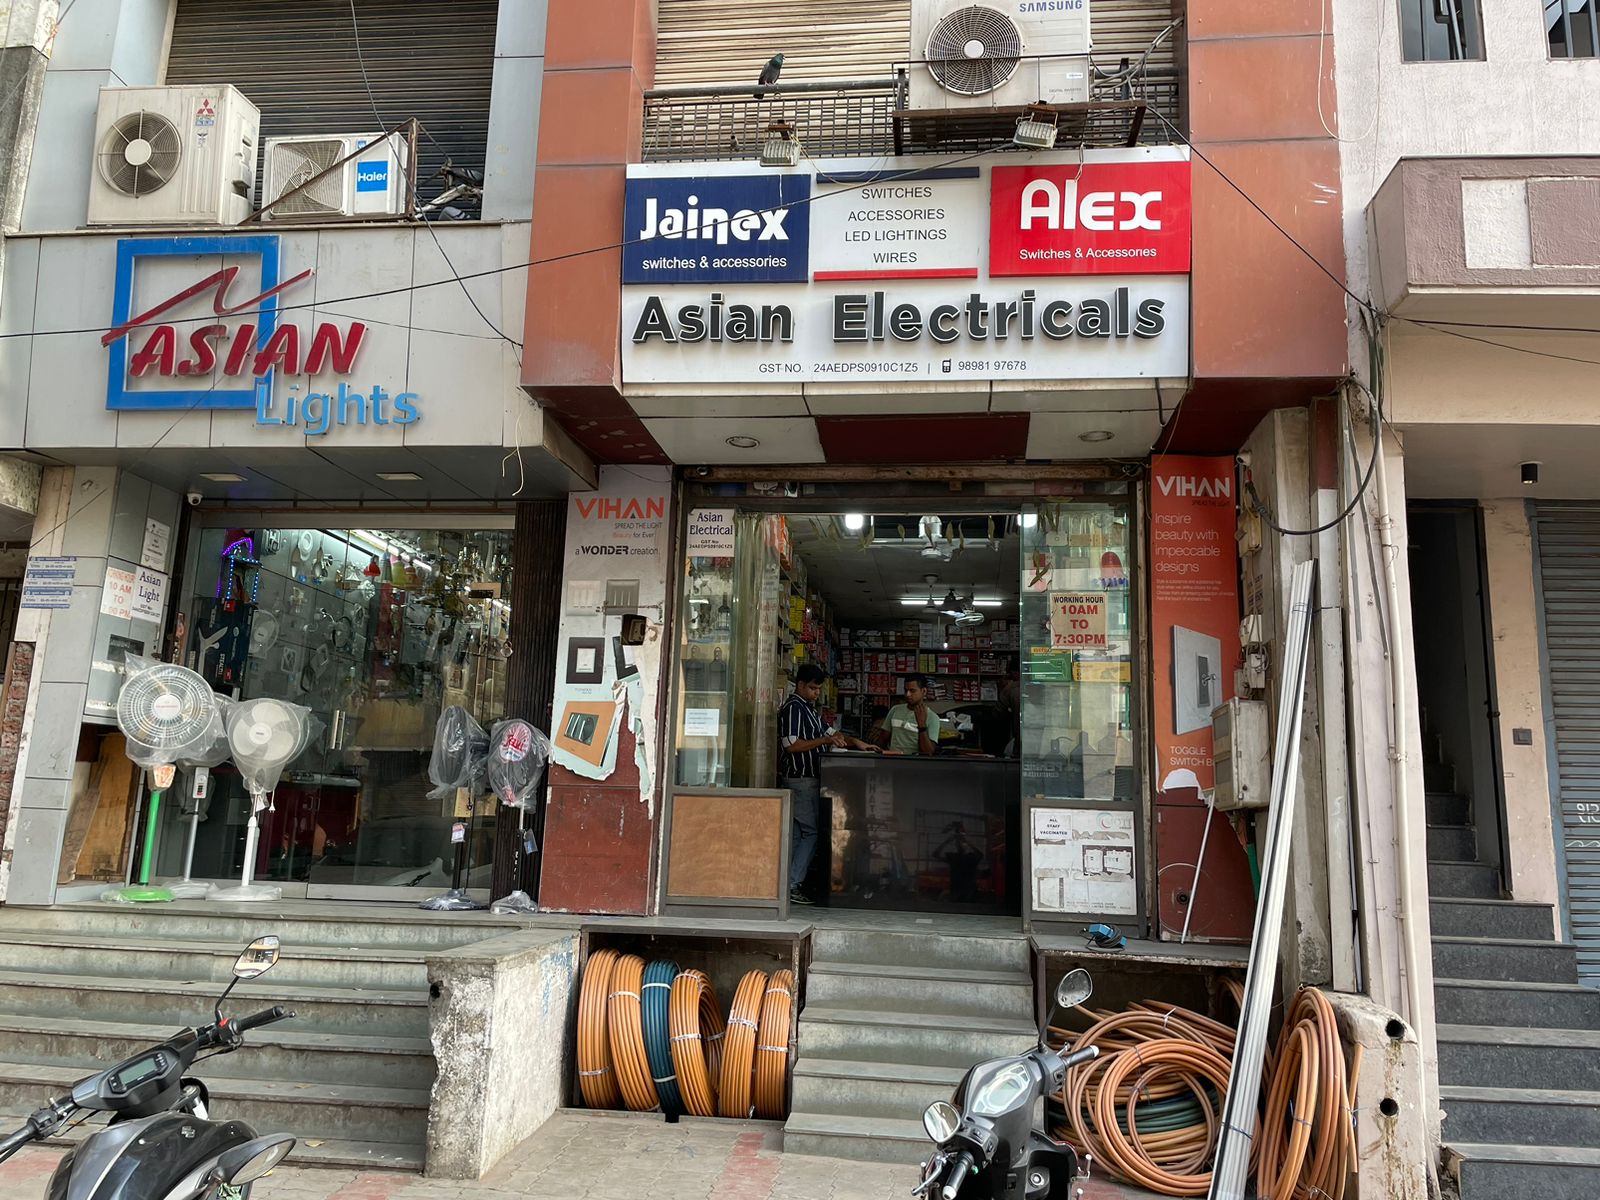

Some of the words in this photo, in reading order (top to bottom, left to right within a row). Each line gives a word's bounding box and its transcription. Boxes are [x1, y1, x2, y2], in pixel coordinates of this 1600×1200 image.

[1019, 0, 1083, 13] SAMSUNG
[357, 171, 388, 182] Haier
[861, 186, 933, 200] SWITCHES
[847, 208, 945, 222] ACCESSORIES
[844, 229, 870, 242] LED
[873, 228, 948, 242] LIGHTINGS
[873, 251, 918, 264] WIRES
[1019, 247, 1072, 260] Switches
[1074, 247, 1084, 259] &
[1086, 245, 1157, 260] Accessories
[642, 256, 697, 270] switches
[699, 257, 709, 269] &
[712, 255, 787, 269] accessories
[632, 291, 794, 345] Asian
[833, 286, 1166, 342] Electricals
[130, 322, 368, 378] ASIAN
[758, 362, 781, 374] GST
[783, 362, 804, 374] NO.
[813, 361, 919, 374] 24AEDPS0910C1Z5
[957, 360, 991, 372] 98981
[993, 359, 1027, 372] 97678
[254, 381, 422, 437] Lights
[1155, 475, 1231, 498] VIHAN
[575, 496, 665, 520] VIHAN
[696, 511, 723, 523] Asian
[1155, 513, 1192, 526] Inspire
[614, 522, 634, 530] SPREAD
[635, 522, 646, 530] THE
[689, 524, 733, 536] Electrical
[633, 531, 641, 539] for
[1155, 529, 1193, 542] beauty
[1196, 530, 1219, 541] with
[581, 545, 628, 556] WONDER
[1155, 545, 1221, 559] impeccable
[1155, 561, 1200, 575] designs
[139, 571, 161, 587] Asian
[119, 584, 132, 594] AM
[138, 585, 160, 604] Light
[1053, 596, 1084, 604] WORKING
[1085, 596, 1104, 604] HOUR
[1061, 604, 1098, 615] 10AM
[1070, 619, 1089, 630] TO
[1055, 634, 1106, 645] 7:30PM
[1169, 745, 1207, 756] TOGGLE
[1169, 756, 1205, 767] SWITCH
